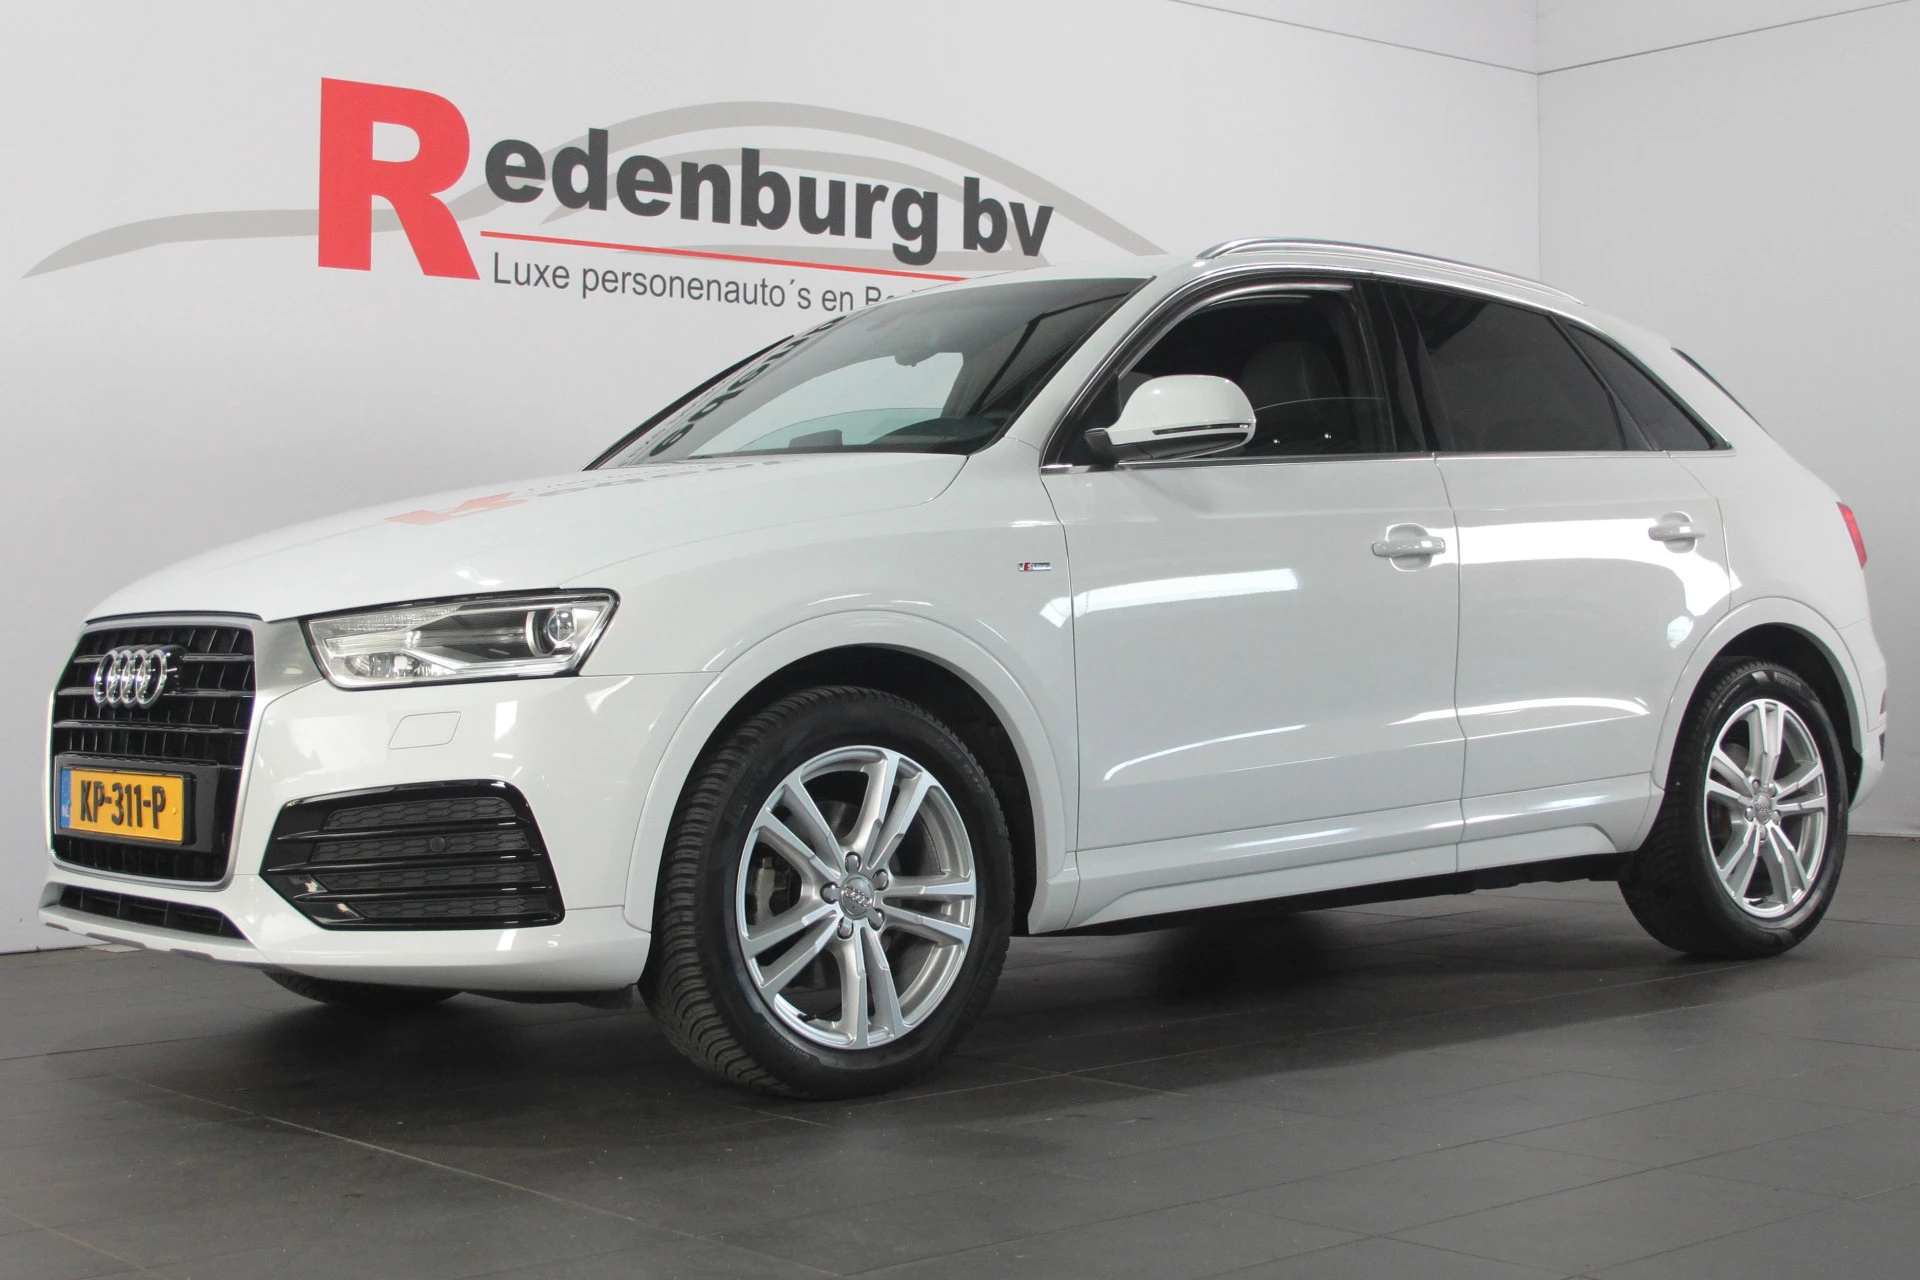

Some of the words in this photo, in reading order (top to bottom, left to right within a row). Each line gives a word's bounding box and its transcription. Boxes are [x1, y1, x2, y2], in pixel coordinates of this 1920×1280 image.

[318, 78, 938, 280] Redenburg
[963, 177, 1054, 257] bv
[494, 251, 570, 290] Luxe
[821, 289, 854, 313] en
[80, 780, 167, 829] KP-311-P
